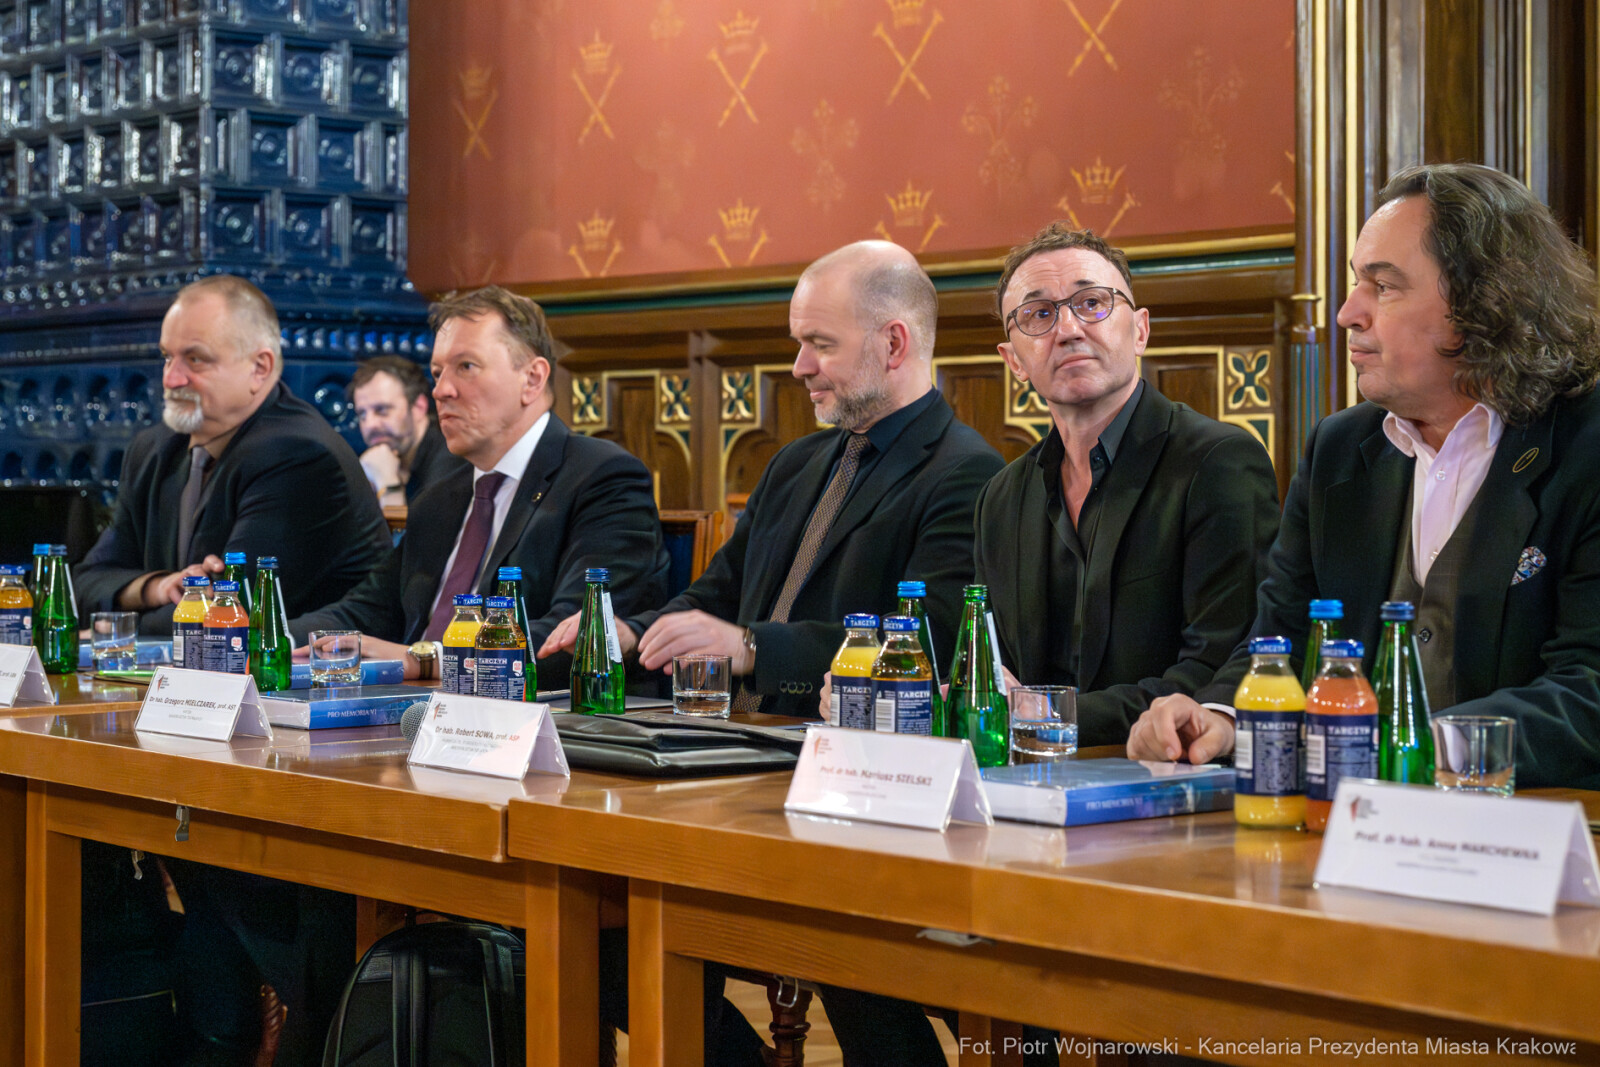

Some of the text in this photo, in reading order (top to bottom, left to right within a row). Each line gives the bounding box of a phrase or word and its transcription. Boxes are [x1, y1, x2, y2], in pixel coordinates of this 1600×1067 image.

[843, 686, 872, 694] TARCZY
[164, 697, 184, 706] Grzegorz
[442, 726, 454, 735] hab.
[455, 728, 475, 737] Robert
[475, 729, 494, 739] SOWA,
[861, 769, 894, 782] Mariusz
